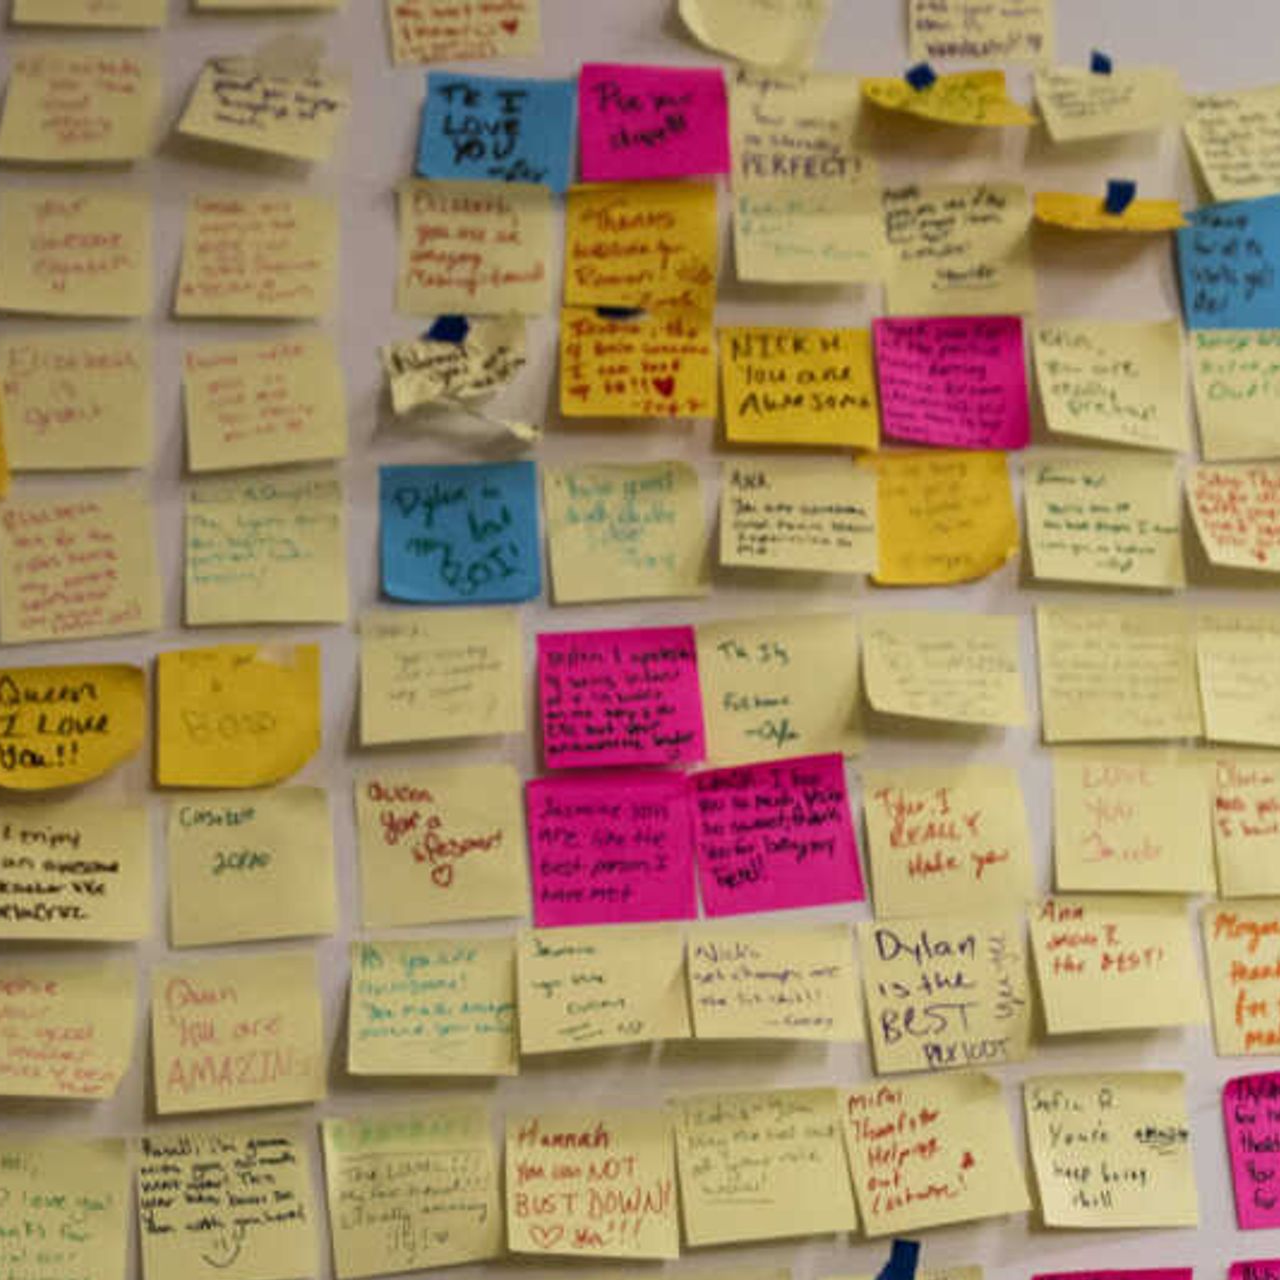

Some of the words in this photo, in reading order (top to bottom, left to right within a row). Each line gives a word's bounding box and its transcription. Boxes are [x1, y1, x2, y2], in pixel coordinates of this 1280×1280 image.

[873, 927, 978, 960] Dylan
[918, 974, 976, 996] the
[518, 1119, 611, 1150] Hannah
